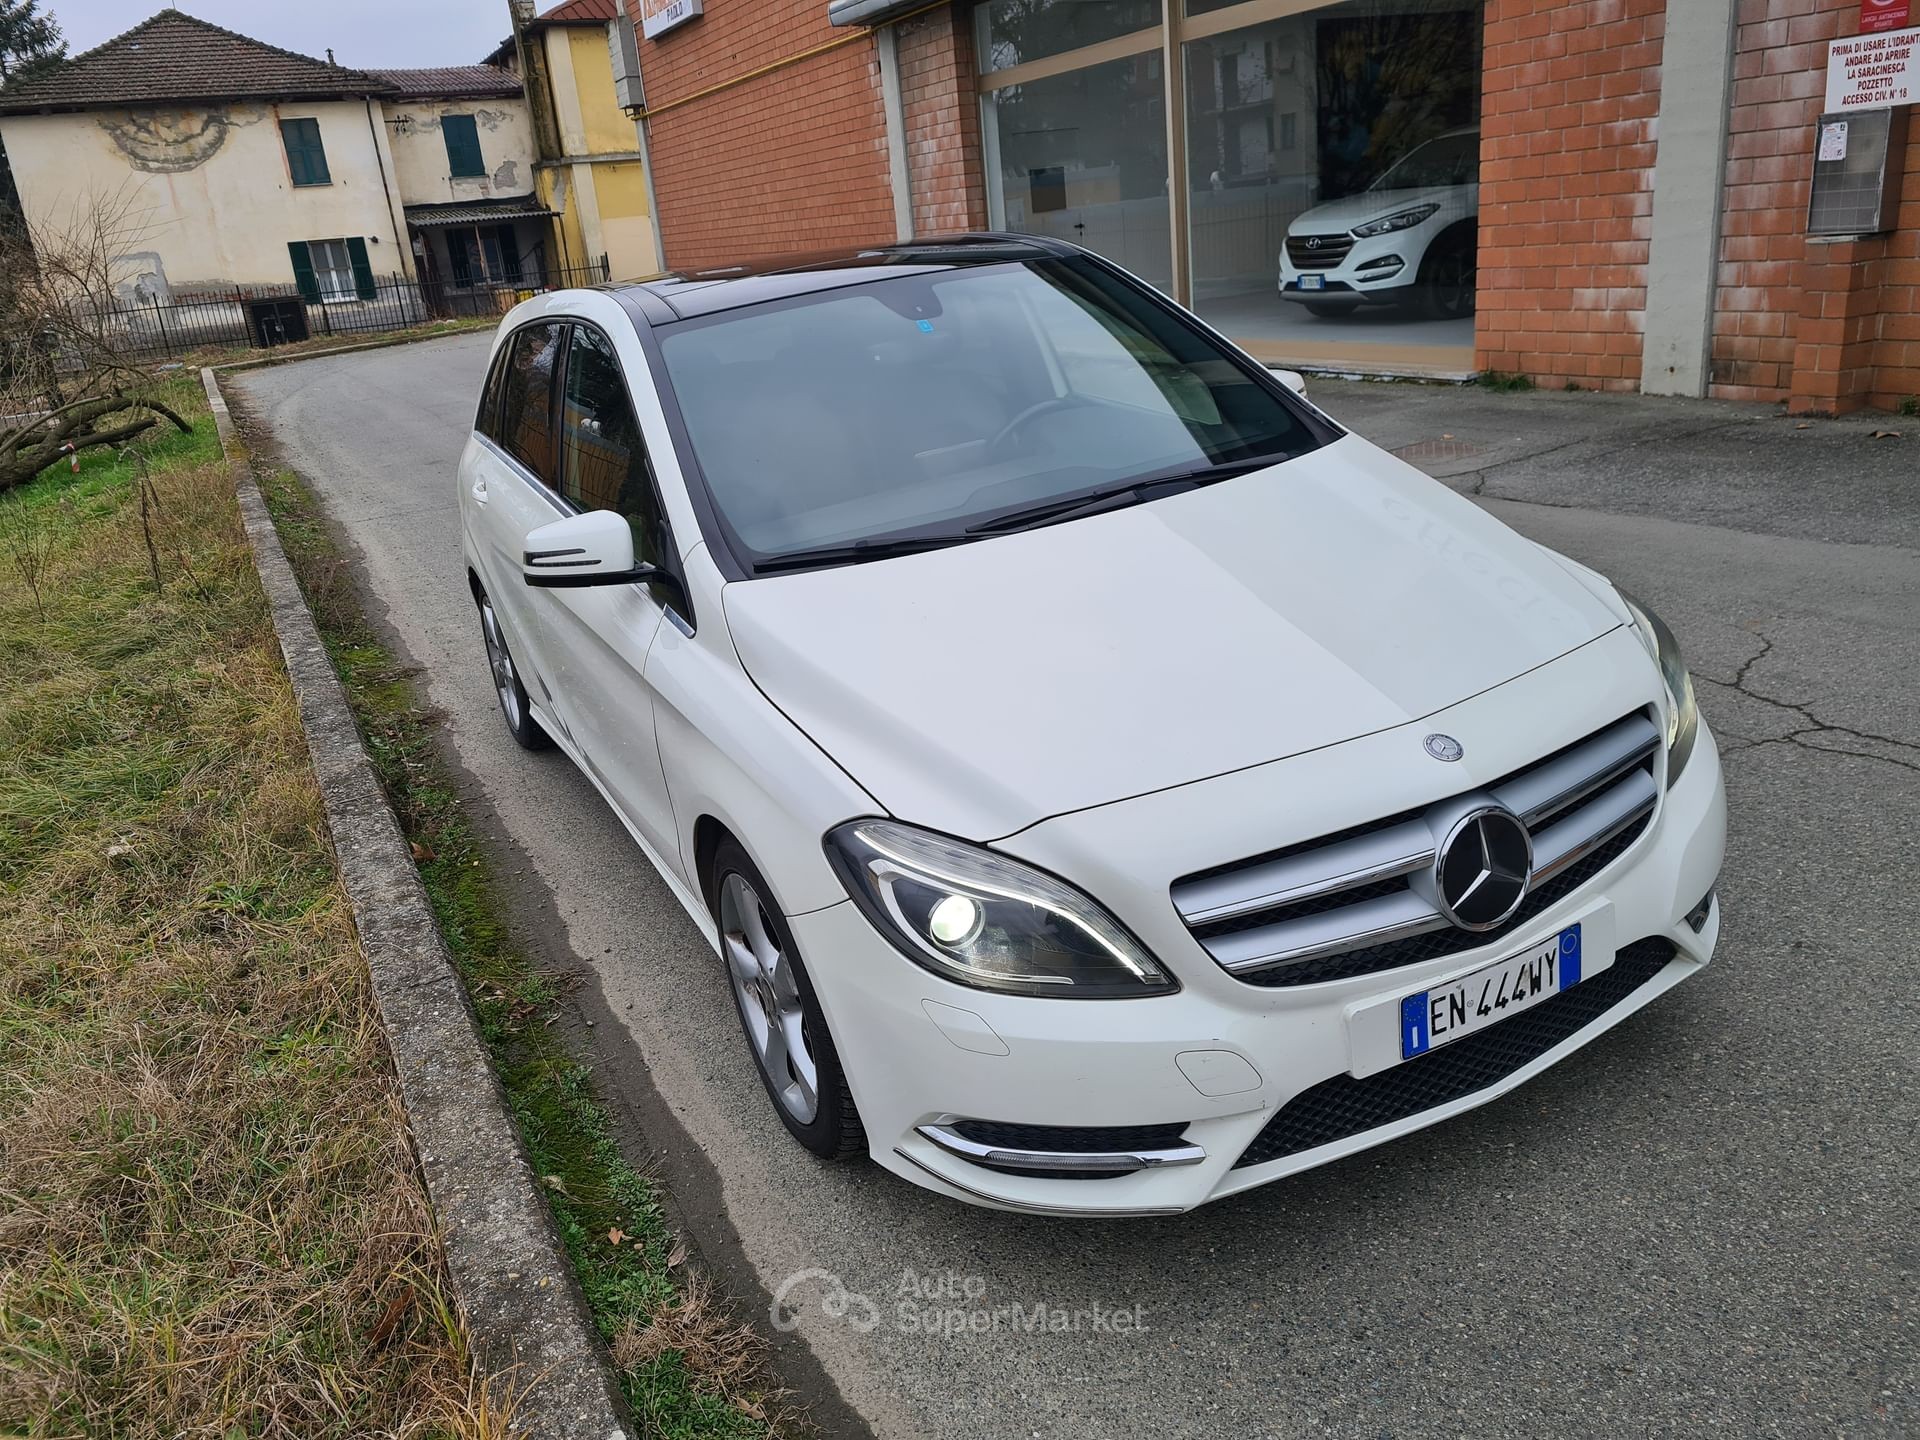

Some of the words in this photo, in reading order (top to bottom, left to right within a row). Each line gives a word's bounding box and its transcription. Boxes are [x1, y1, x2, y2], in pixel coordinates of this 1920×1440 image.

[1832, 44, 1852, 56] PRIMA
[1855, 43, 1861, 53] DI
[1864, 39, 1886, 51] USARE
[1888, 34, 1920, 48] L'IDRANT
[1845, 54, 1872, 68] ANDARE
[1873, 53, 1883, 63] AD
[1885, 48, 1910, 61] APRIRE
[1847, 69, 1856, 79] LA
[1857, 62, 1905, 78] SARACINESCA
[1857, 77, 1893, 90] POZZETTO
[1842, 93, 1873, 105] ACCESSO
[1874, 90, 1887, 101] CIV.
